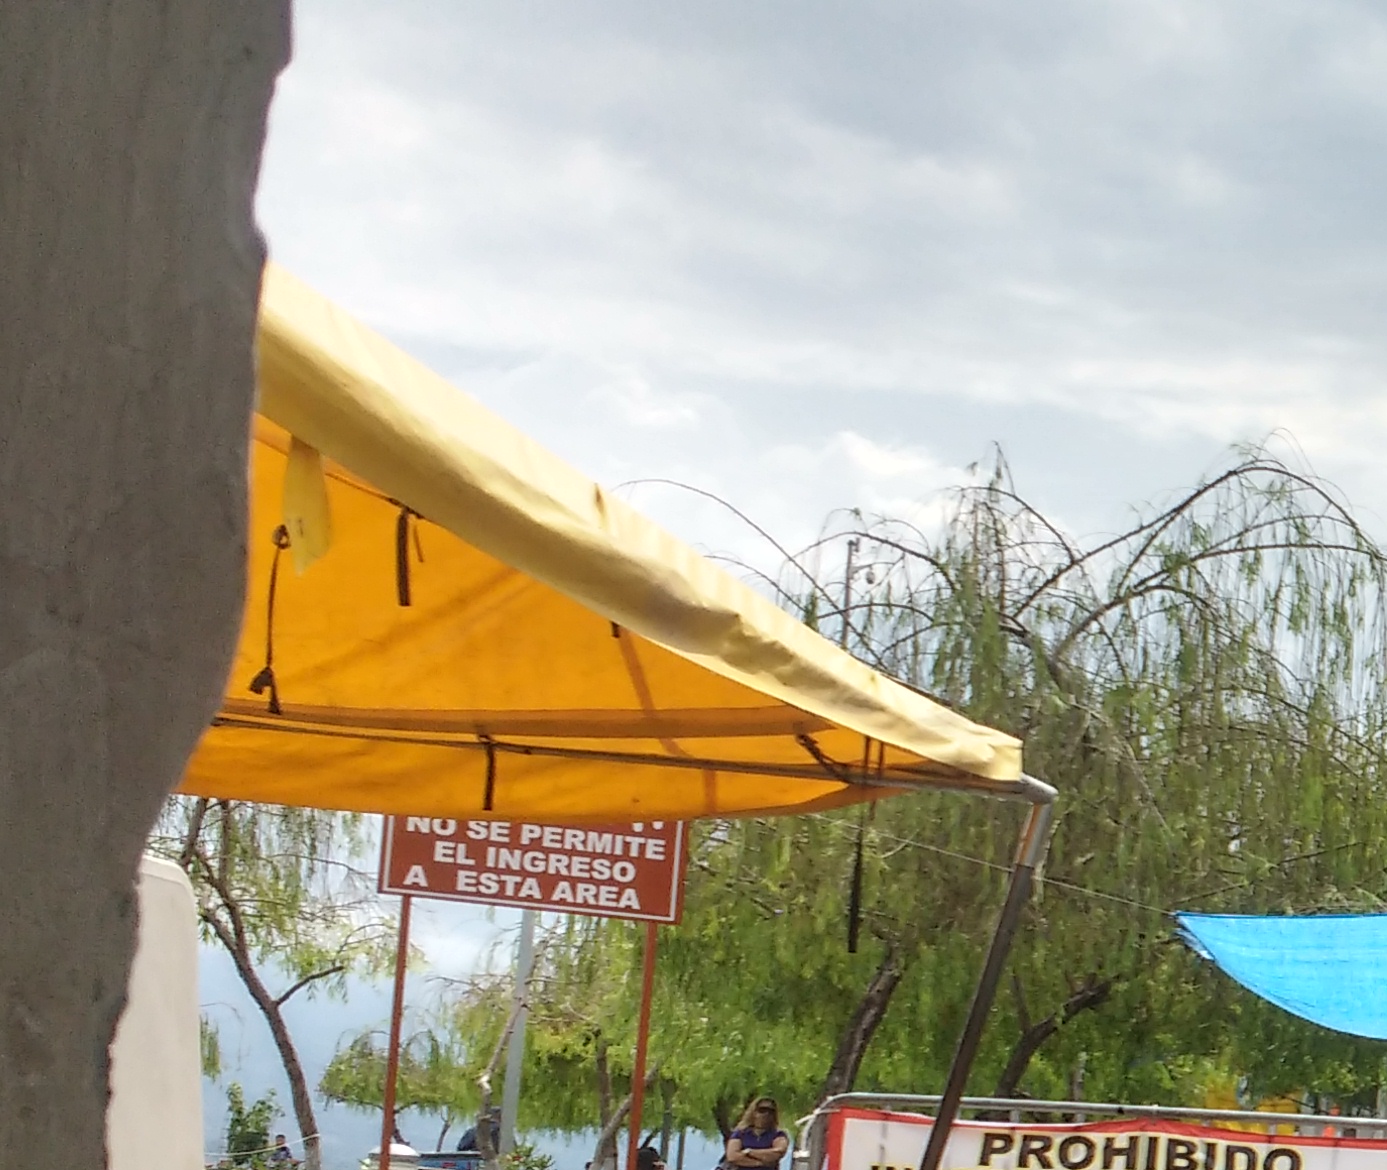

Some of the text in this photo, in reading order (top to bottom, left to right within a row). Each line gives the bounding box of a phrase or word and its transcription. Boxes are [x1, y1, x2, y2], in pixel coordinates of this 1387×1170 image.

[406, 816, 457, 837] NO
[467, 820, 511, 843] SE
[520, 823, 666, 861] PERMITE
[433, 840, 636, 884] EL INGRESO
[403, 865, 641, 911] A ESTA AREA
